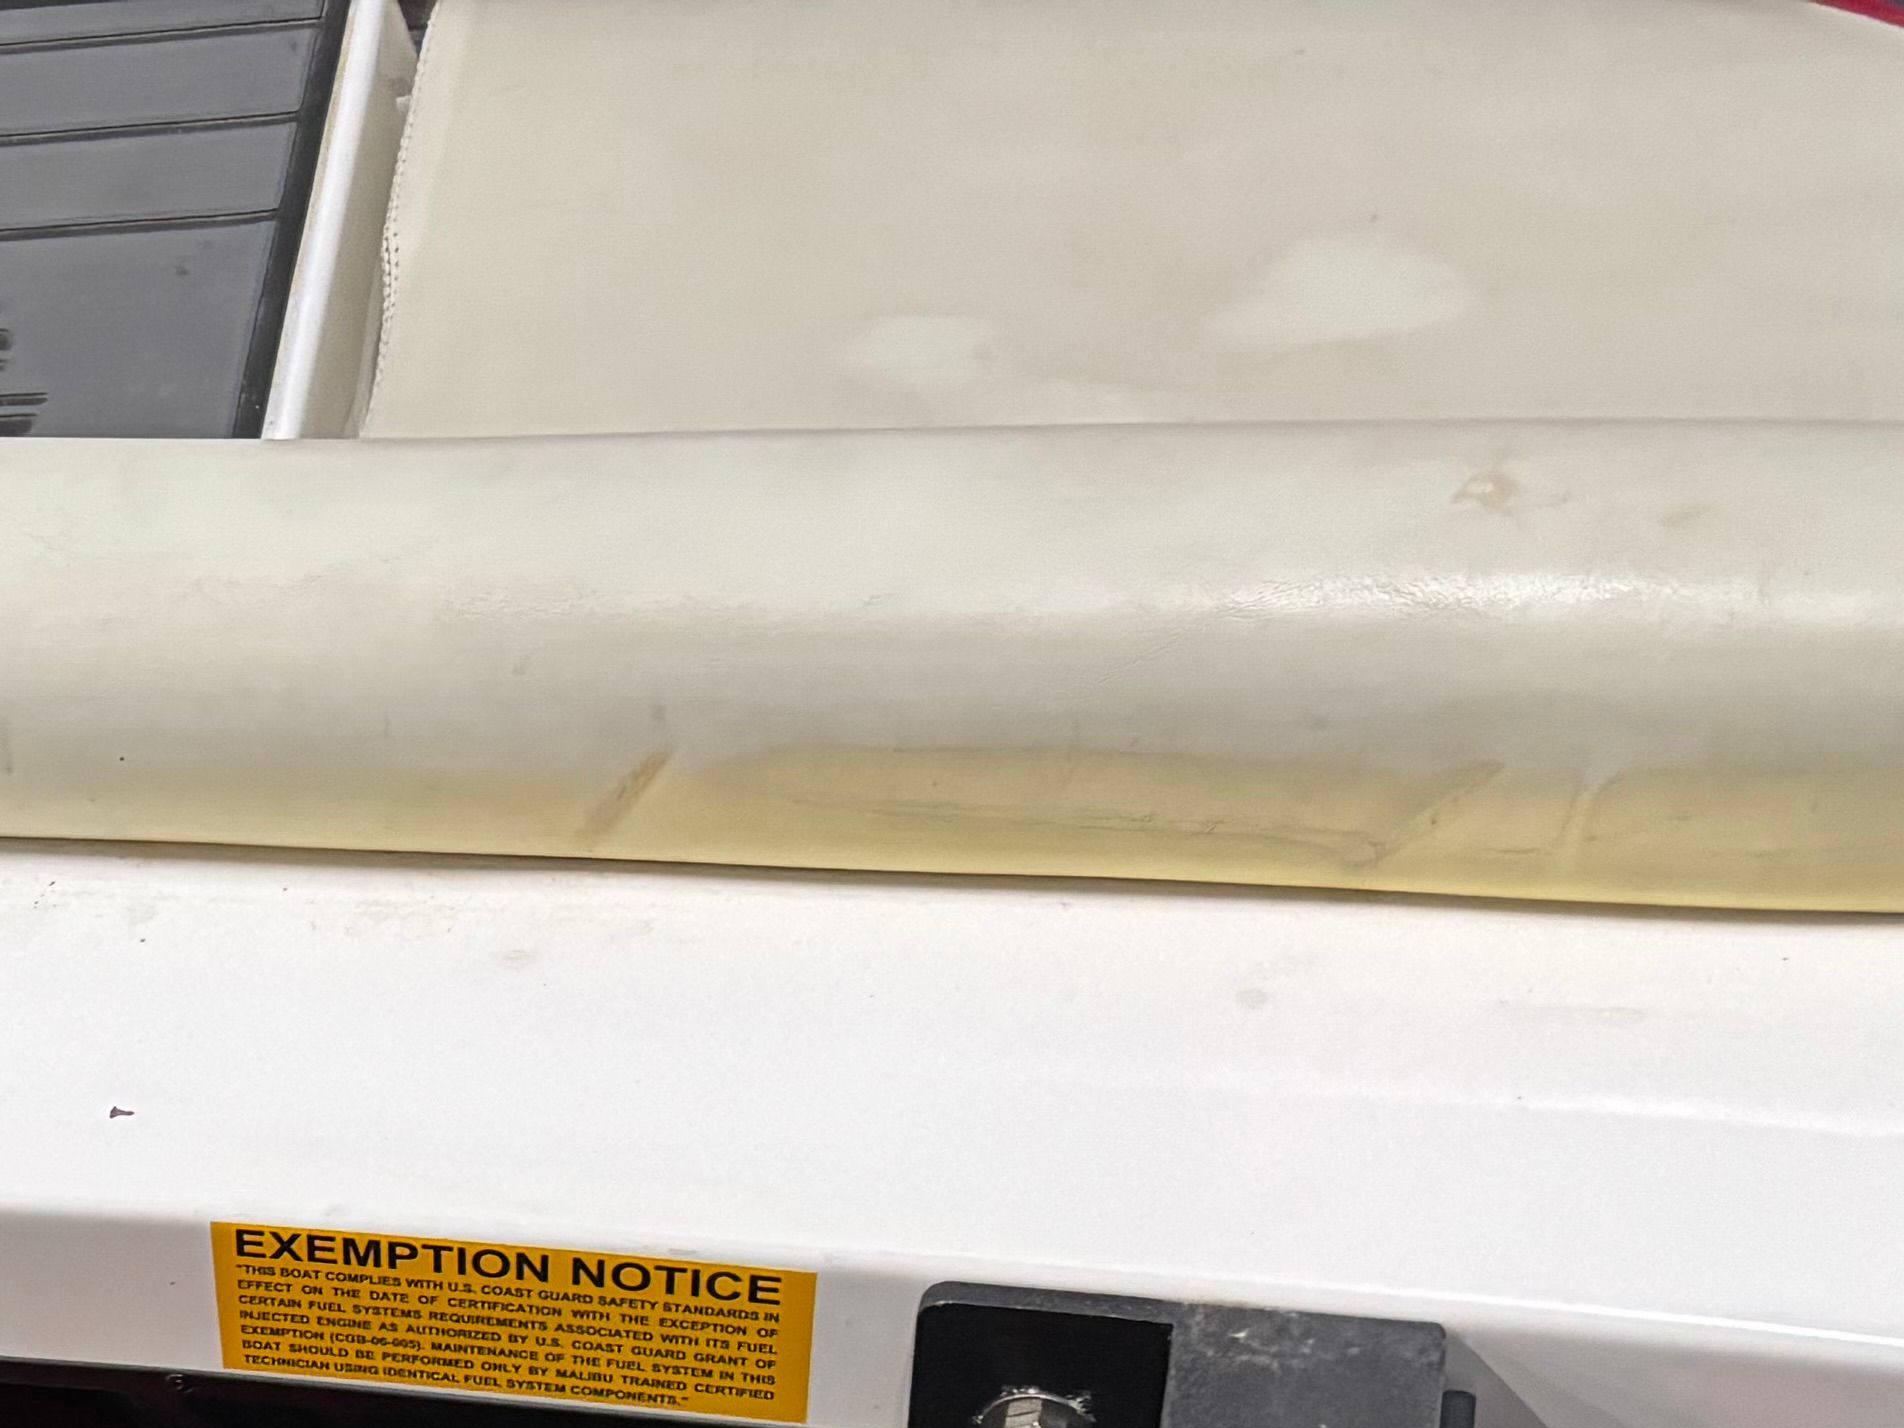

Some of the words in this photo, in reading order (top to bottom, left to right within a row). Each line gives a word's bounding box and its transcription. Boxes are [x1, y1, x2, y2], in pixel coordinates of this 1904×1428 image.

[235, 1228, 550, 1283] EXEMPTION
[572, 1257, 782, 1306] NOTICE
[280, 1267, 321, 1280] BOAT
[325, 1271, 401, 1287] COMPLIES
[405, 1278, 443, 1291] WITH
[447, 1281, 477, 1294] U.S.
[481, 1284, 533, 1298] COAST
[538, 1289, 592, 1304] GUARD
[598, 1295, 658, 1311] SAFETY
[662, 1302, 758, 1321] STANDARDS
[763, 1311, 779, 1323] IN
[237, 1278, 292, 1293] EFFECT
[301, 1284, 323, 1296] ON
[333, 1287, 360, 1299] THE
[370, 1290, 408, 1304] DATE
[418, 1294, 439, 1306] OF
[447, 1297, 562, 1318] CERTIFICATION
[571, 1309, 610, 1322] WITH
[619, 1313, 649, 1326] THE
[659, 1317, 747, 1336] EXCEPTION
[756, 1327, 778, 1339] OF
[238, 1293, 301, 1309] CERTAIN
[308, 1300, 345, 1313] FUEL
[352, 1304, 421, 1320] SYSTEMS
[429, 1311, 548, 1332] REQUIREMENTS
[554, 1323, 653, 1342] ASSOCIATED
[660, 1333, 698, 1347] WITH
[705, 1337, 729, 1350] ITS
[736, 1340, 777, 1354] FUEL
[239, 1308, 310, 1325] INJECTED
[316, 1316, 371, 1330] ENGINE
[378, 1321, 398, 1333] AS
[405, 1324, 501, 1342] AUTHORIZED
[508, 1334, 528, 1345] BY
[535, 1336, 563, 1348] U.S.
[571, 1340, 624, 1354] COAST
[631, 1345, 687, 1361] GUARD
[693, 1352, 747, 1367] GRANT
[755, 1358, 776, 1369] OF
[241, 1324, 324, 1341] EXEMPTION
[431, 1341, 537, 1361] MAINTENANCE
[544, 1352, 564, 1364] OF
[571, 1355, 600, 1367] THE
[606, 1358, 644, 1372] FUEL
[651, 1363, 713, 1378] SYSTEM
[719, 1369, 734, 1381] IN
[740, 1371, 775, 1385] THIS
[242, 1338, 281, 1352] BOAT
[288, 1343, 348, 1358] SHOULD
[355, 1349, 374, 1361] BE
[382, 1351, 474, 1370] PERFORMED
[480, 1361, 521, 1374] ONLY
[528, 1365, 548, 1377] BY
[555, 1368, 613, 1384] MALIBU
[621, 1374, 686, 1391] TRAINED
[694, 1382, 774, 1400] CERTIFIED
[244, 1353, 329, 1371] TECHNICIAN
[334, 1362, 379, 1376] USING
[383, 1367, 459, 1383] IDENTICAL
[464, 1374, 501, 1387] FUEL
[506, 1378, 565, 1394] SYSTEM
